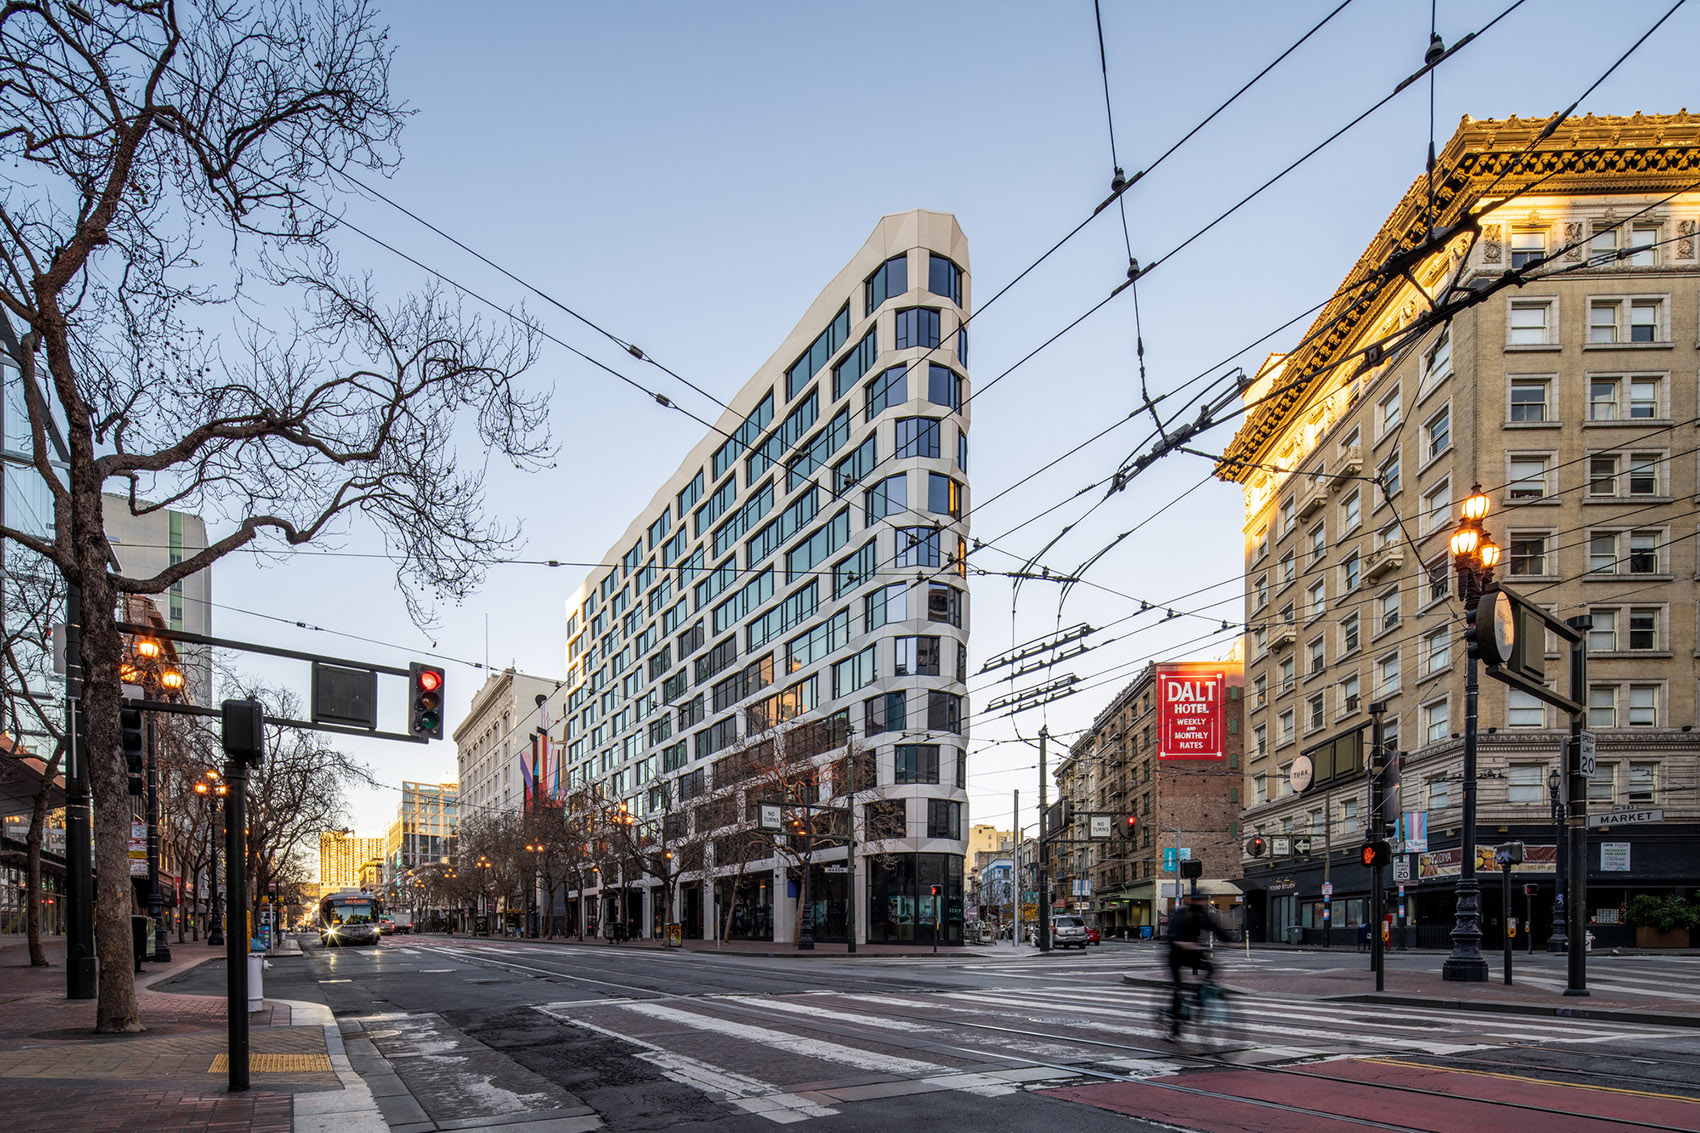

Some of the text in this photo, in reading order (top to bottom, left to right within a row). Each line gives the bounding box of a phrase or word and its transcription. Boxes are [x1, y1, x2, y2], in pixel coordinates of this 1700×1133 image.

[1167, 681, 1217, 702] DALT
[1174, 703, 1210, 714] HOTEL
[1176, 718, 1207, 726] WEEKLY
[1174, 731, 1209, 739] MONTHLY
[1582, 734, 1595, 745] SPEED
[1179, 741, 1204, 749] RATES
[1582, 745, 1593, 754] LIMIT
[1581, 756, 1594, 774] 20
[1293, 769, 1309, 779] TURK
[764, 816, 780, 824] TURNS
[1600, 812, 1653, 824] MARKET
[1397, 871, 1409, 879] 20
